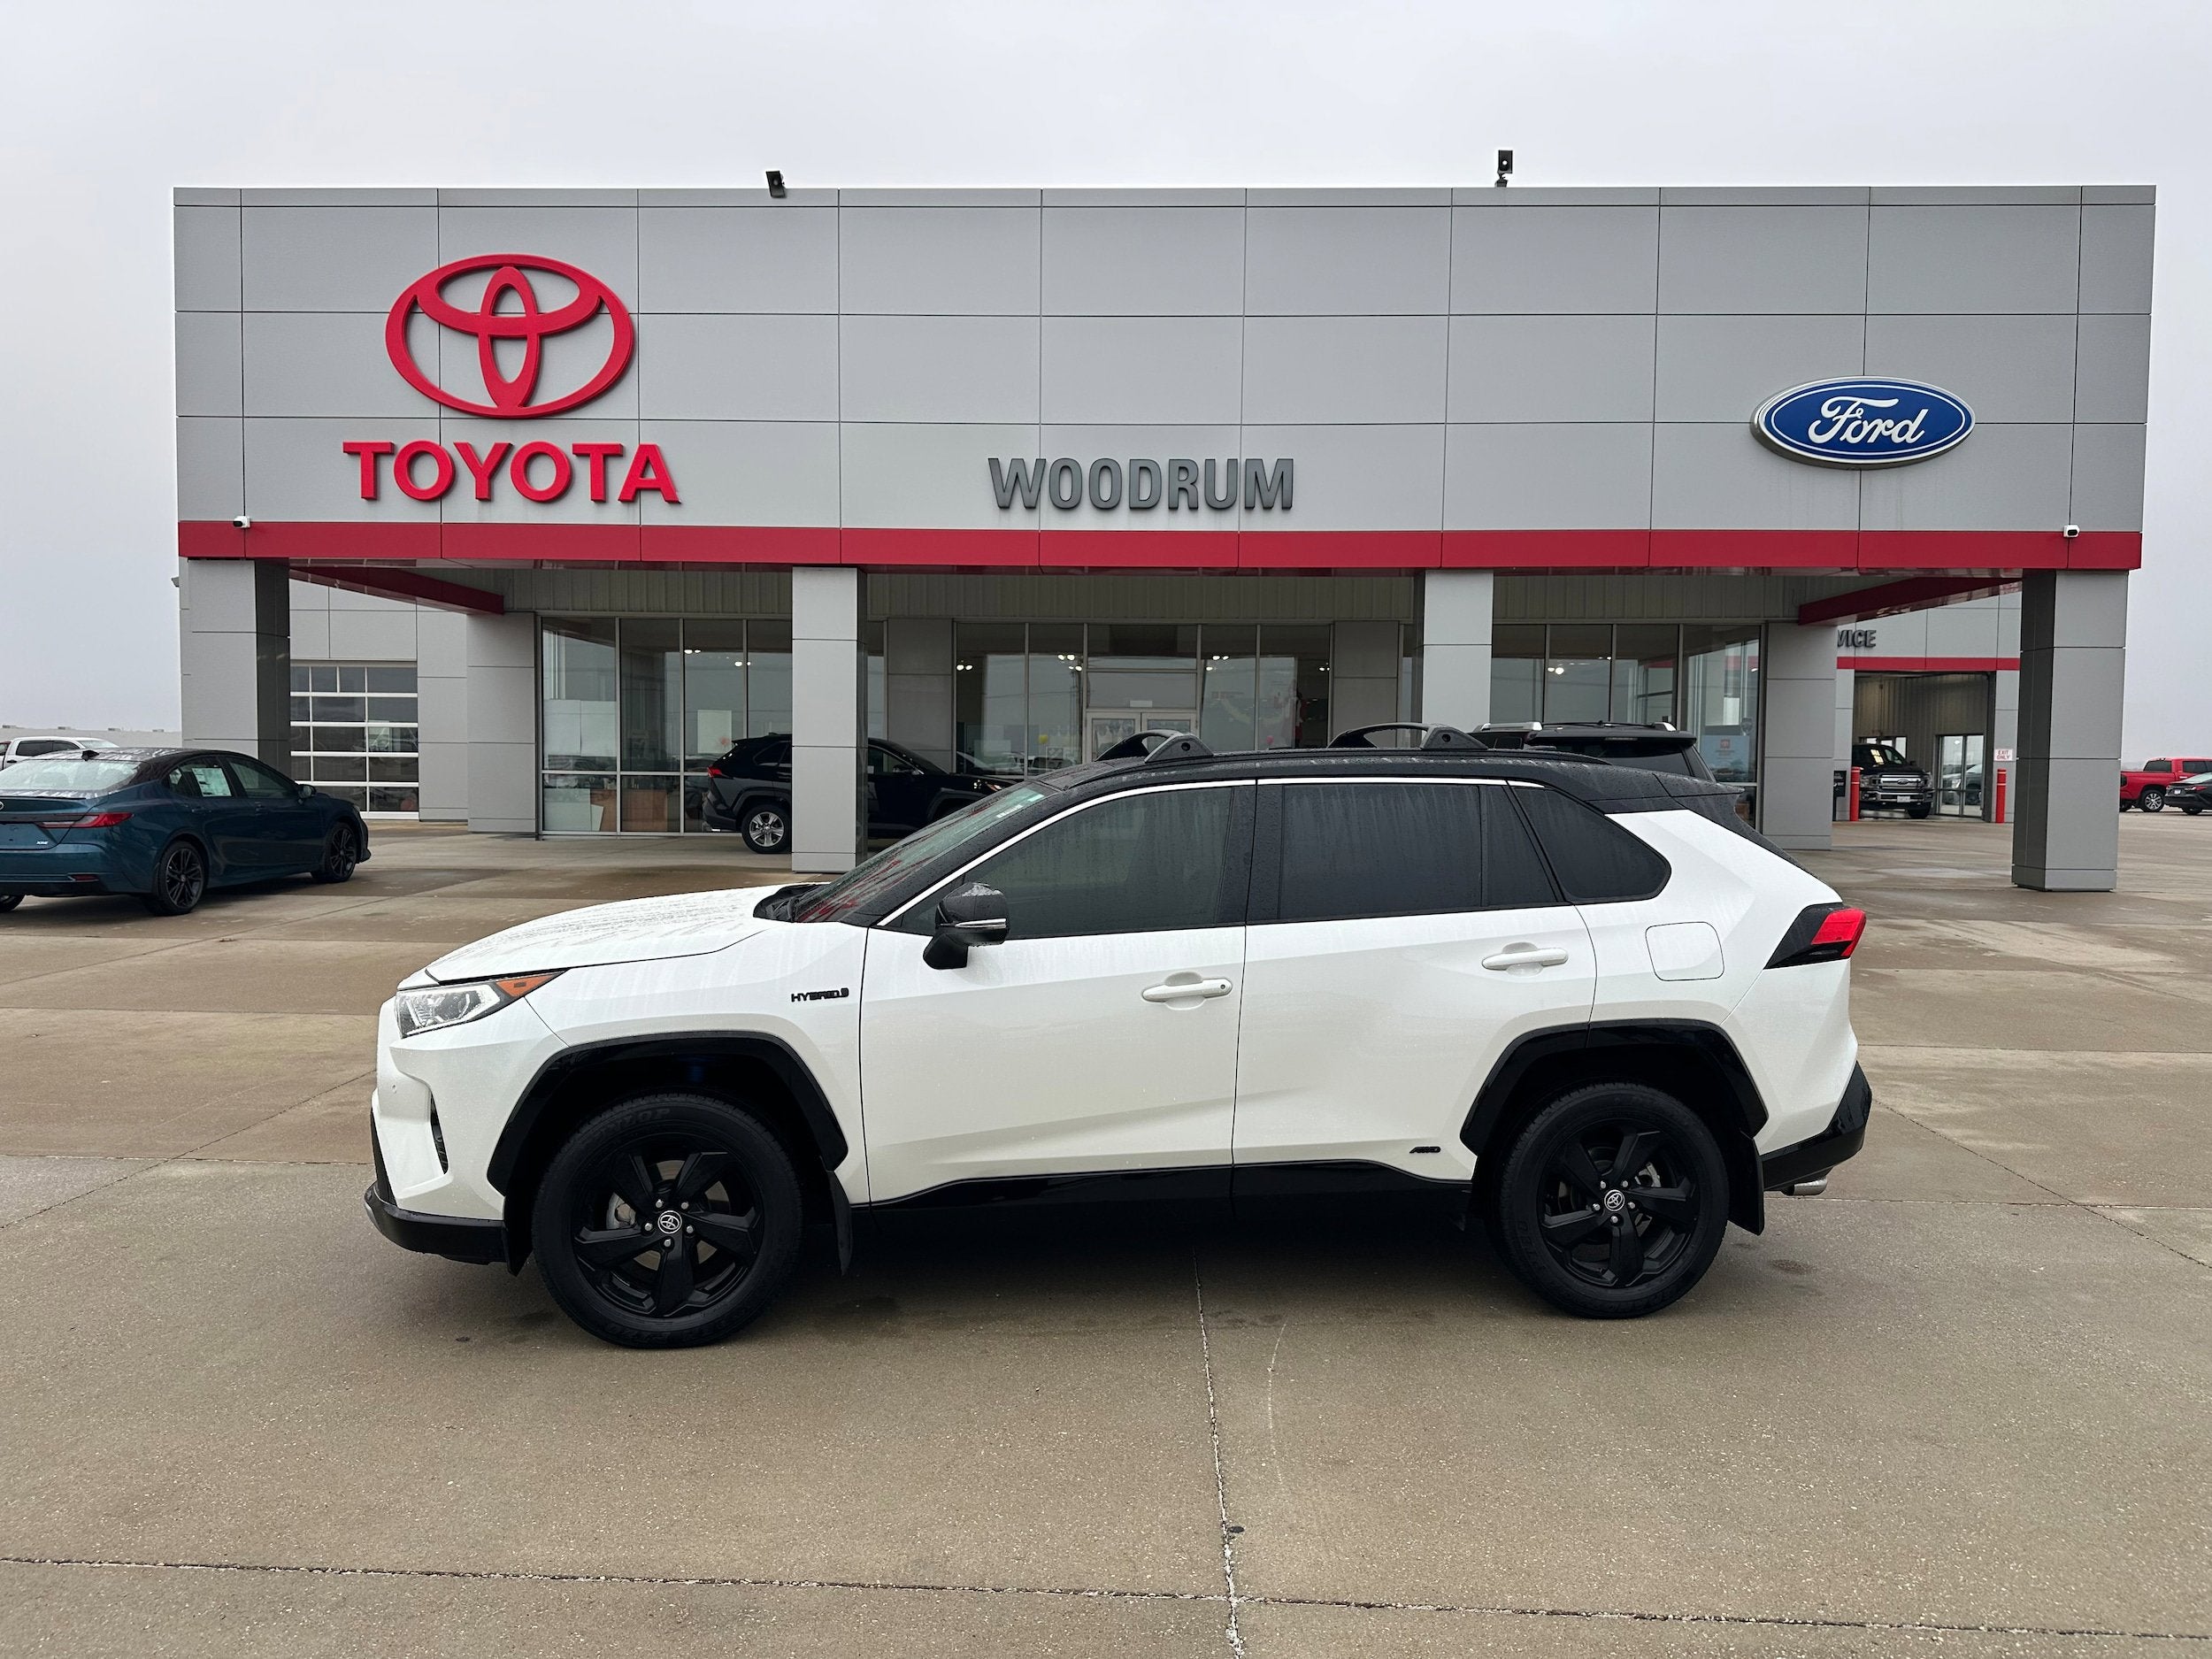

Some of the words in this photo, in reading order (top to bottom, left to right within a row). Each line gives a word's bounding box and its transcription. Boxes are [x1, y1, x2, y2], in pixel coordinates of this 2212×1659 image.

[1808, 396, 1929, 443] Ford
[342, 440, 681, 503] TOYOTA
[988, 457, 1294, 511] WOODRUM
